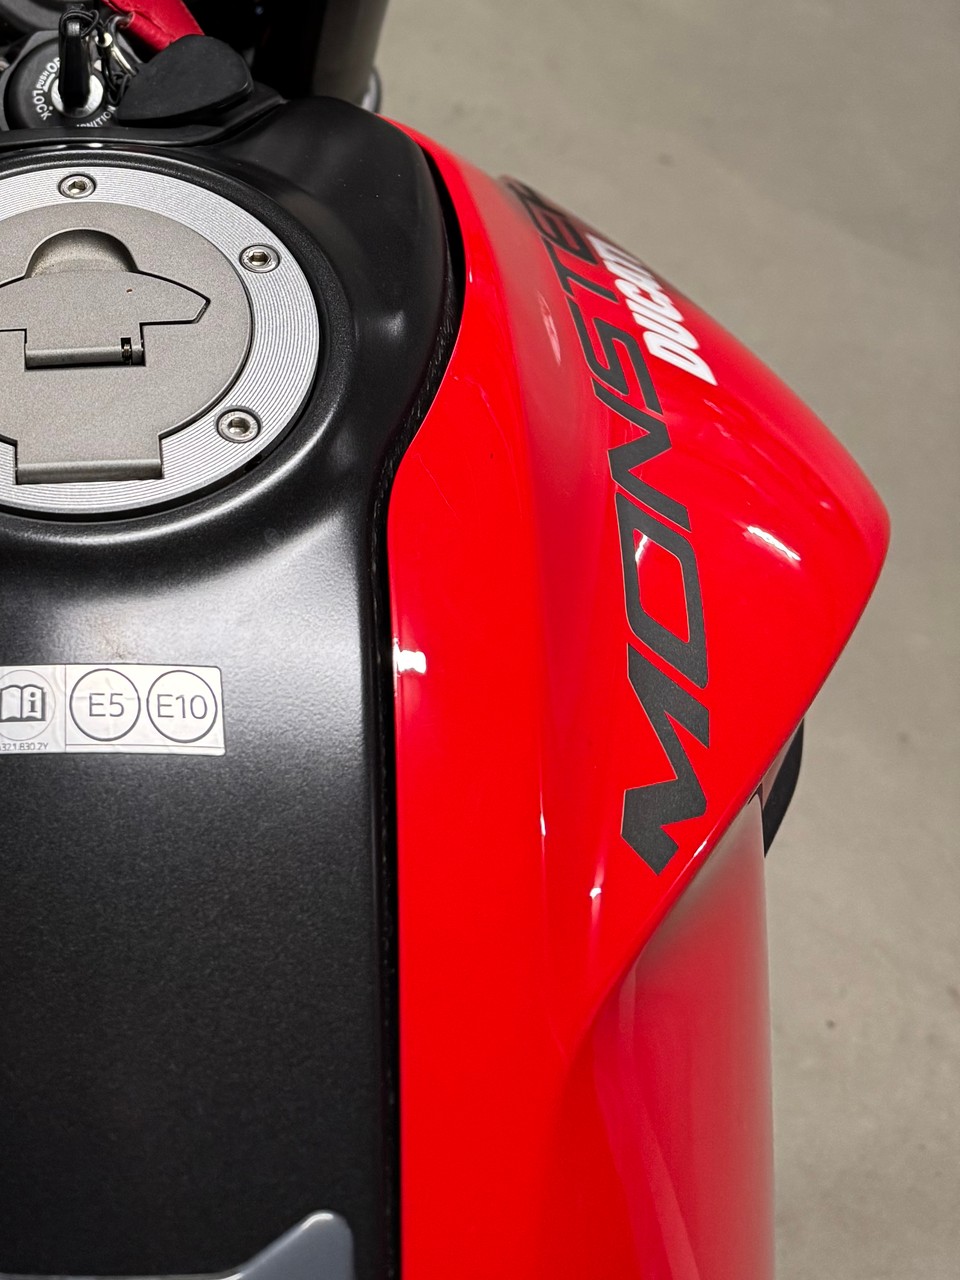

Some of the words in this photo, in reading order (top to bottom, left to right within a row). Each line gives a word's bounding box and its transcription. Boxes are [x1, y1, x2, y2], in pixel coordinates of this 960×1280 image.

[36, 70, 50, 89] PUSH
[32, 90, 52, 120] LOCK
[88, 692, 125, 718] E5
[156, 693, 208, 720] E10
